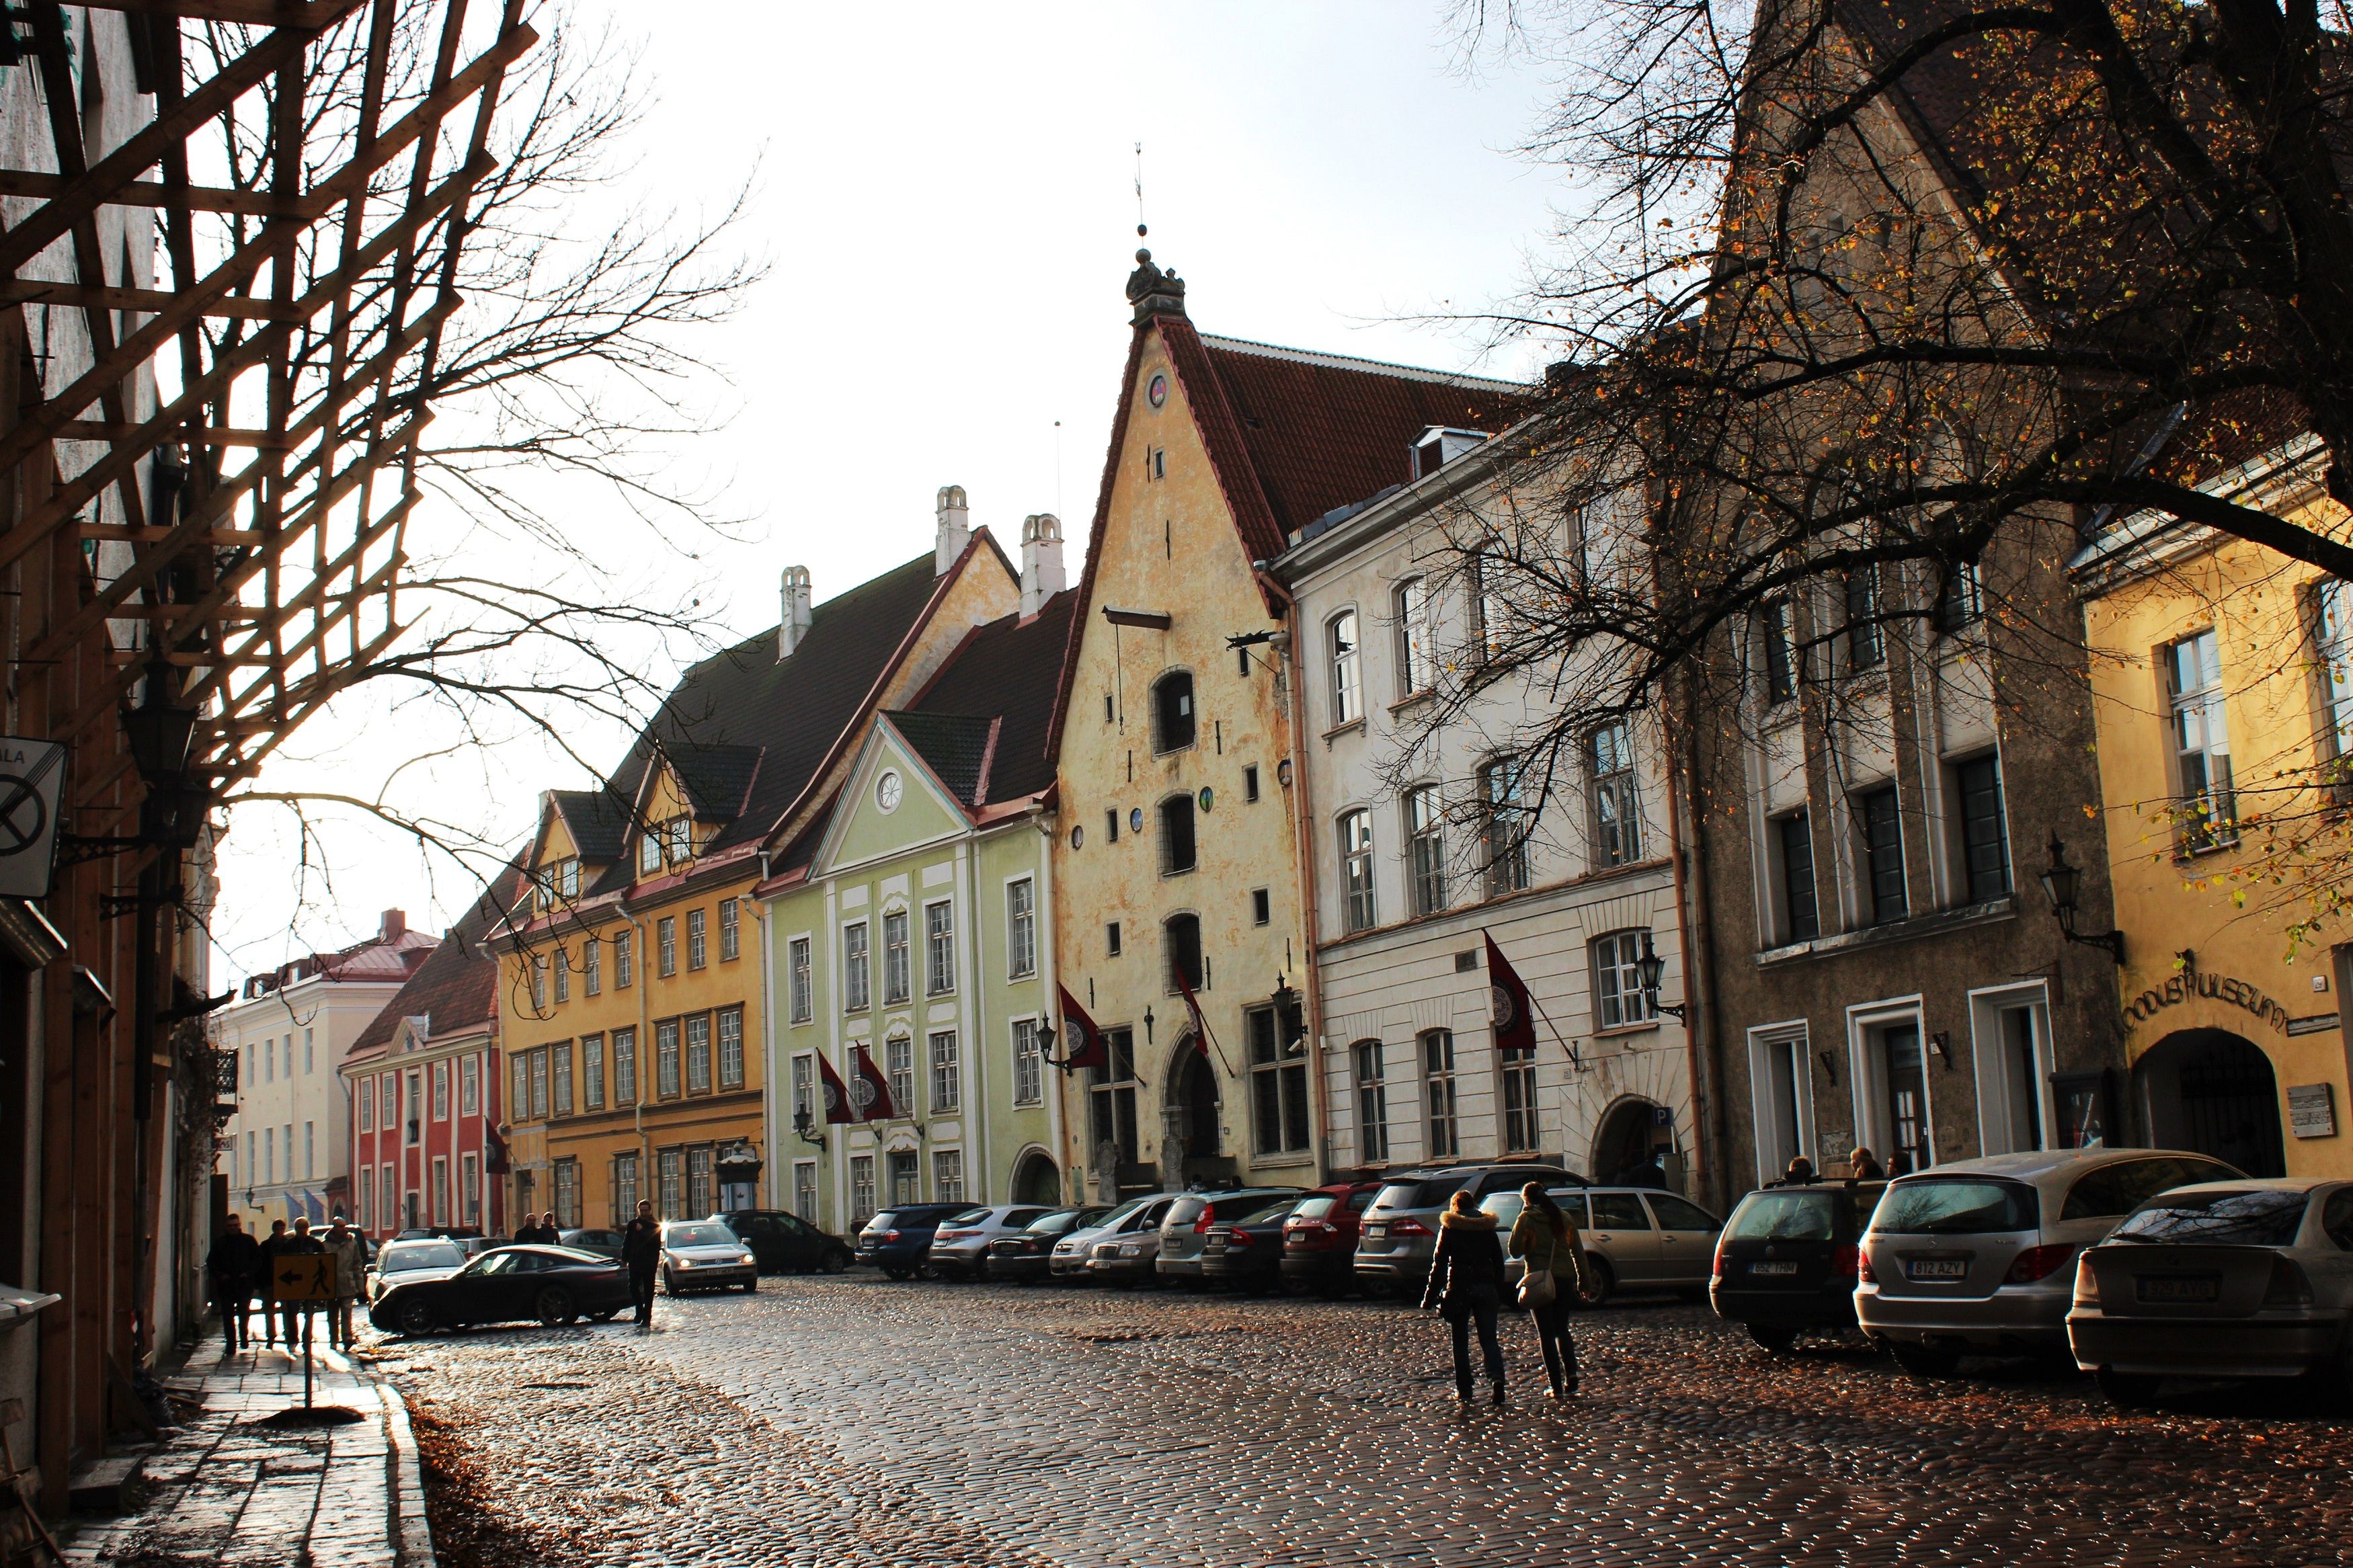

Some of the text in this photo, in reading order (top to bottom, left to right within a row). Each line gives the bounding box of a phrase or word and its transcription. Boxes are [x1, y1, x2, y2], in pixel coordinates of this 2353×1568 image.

[0, 748, 24, 764] LA
[1657, 1110, 1666, 1124] P
[1755, 1262, 1794, 1272] 652 THM
[1916, 1262, 1960, 1274] 812 AZY
